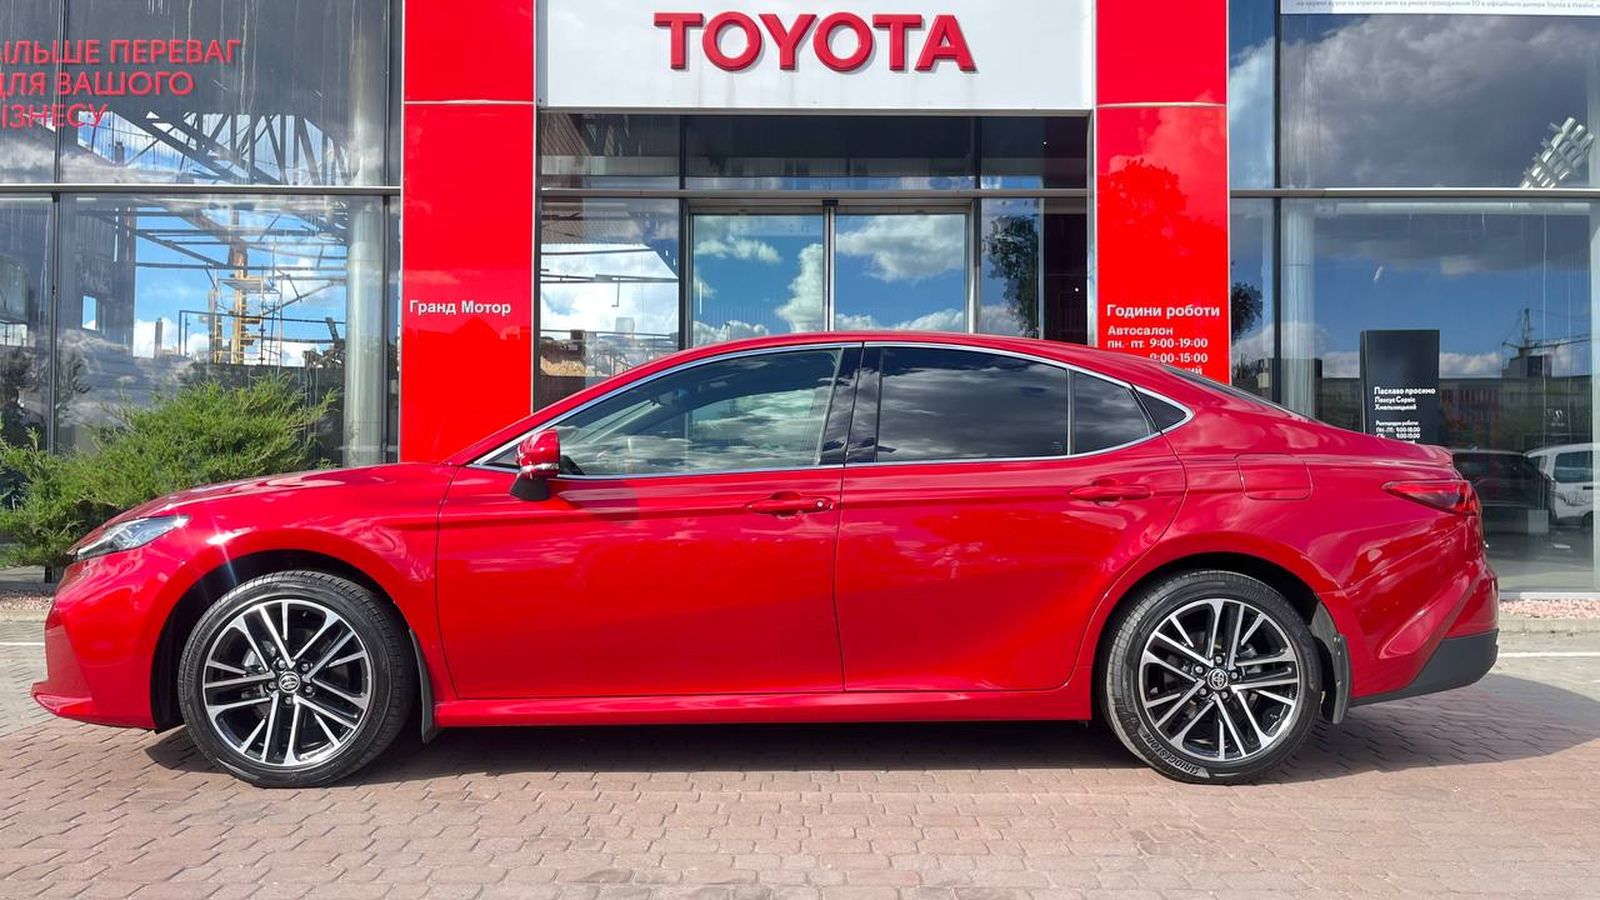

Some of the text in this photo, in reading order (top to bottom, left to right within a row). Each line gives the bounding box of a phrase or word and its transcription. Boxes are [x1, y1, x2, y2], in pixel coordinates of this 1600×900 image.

[0, 39, 241, 65] ІЛЬШЕ ПЕРЕВАГ
[654, 11, 978, 72] TOYOTA
[57, 71, 194, 97] ВАШОГО
[1, 102, 109, 129] ІЗНЕСУ
[409, 299, 511, 317] Гранд Мотор
[1106, 304, 1220, 320] Години роботи
[1107, 325, 1173, 336] Автосалон
[1142, 732, 1200, 776] BRIDGESTONE
